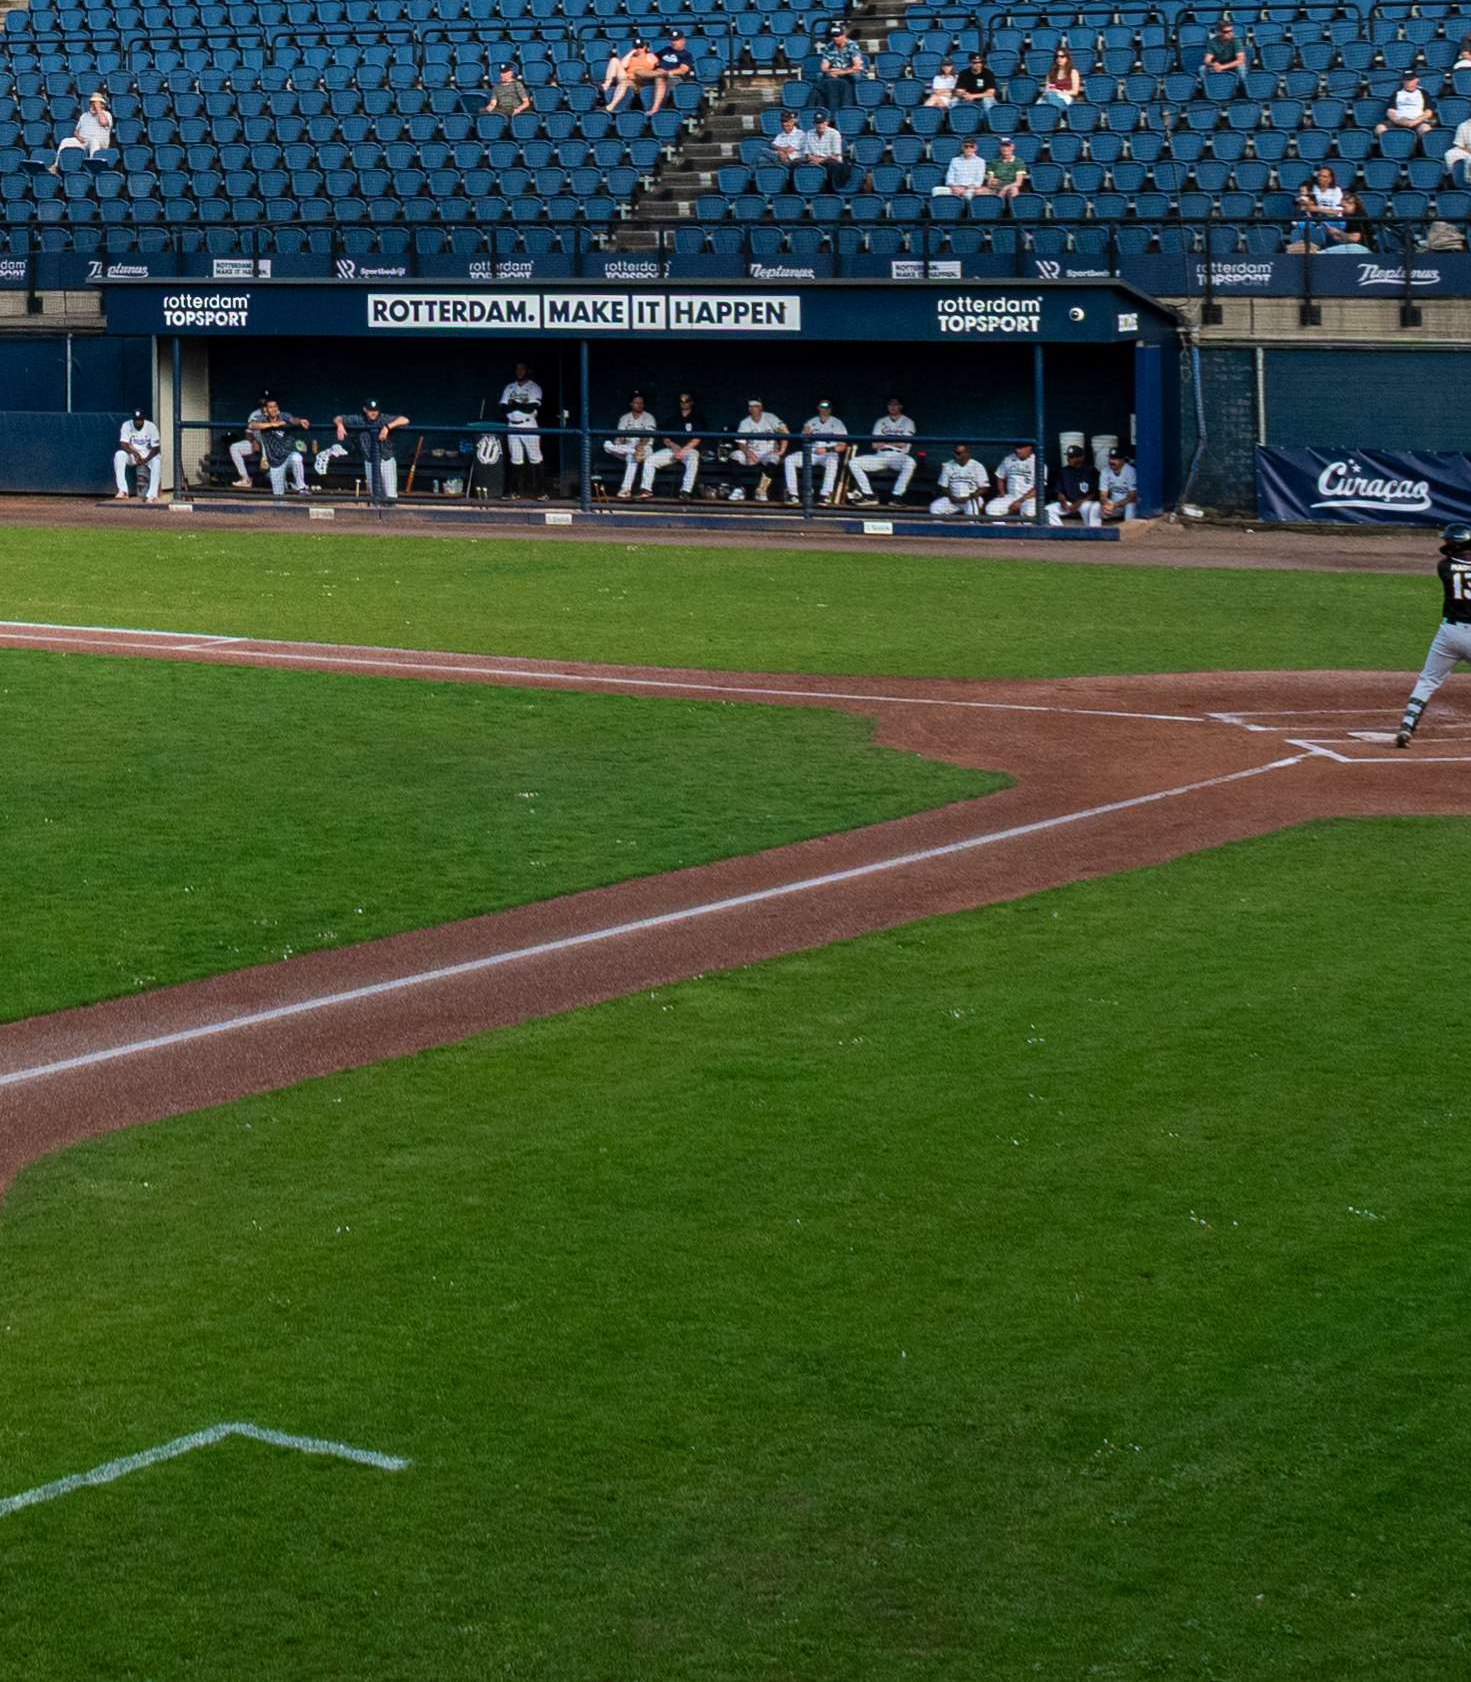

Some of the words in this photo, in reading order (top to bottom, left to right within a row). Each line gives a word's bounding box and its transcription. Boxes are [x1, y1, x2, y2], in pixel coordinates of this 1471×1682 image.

[88, 261, 149, 278] Nptunus
[469, 260, 532, 272] rottrdam
[749, 263, 816, 279] Neptunus
[163, 293, 248, 309] rotterdam
[937, 296, 1041, 313] rotterdam
[164, 310, 248, 327] TOPSPORT
[375, 299, 535, 323] ROTTERDAM.
[549, 301, 625, 325] MAKE
[637, 301, 660, 324] IT
[939, 315, 1041, 333] TOPSPORT
[1311, 461, 1432, 511] Curaçao
